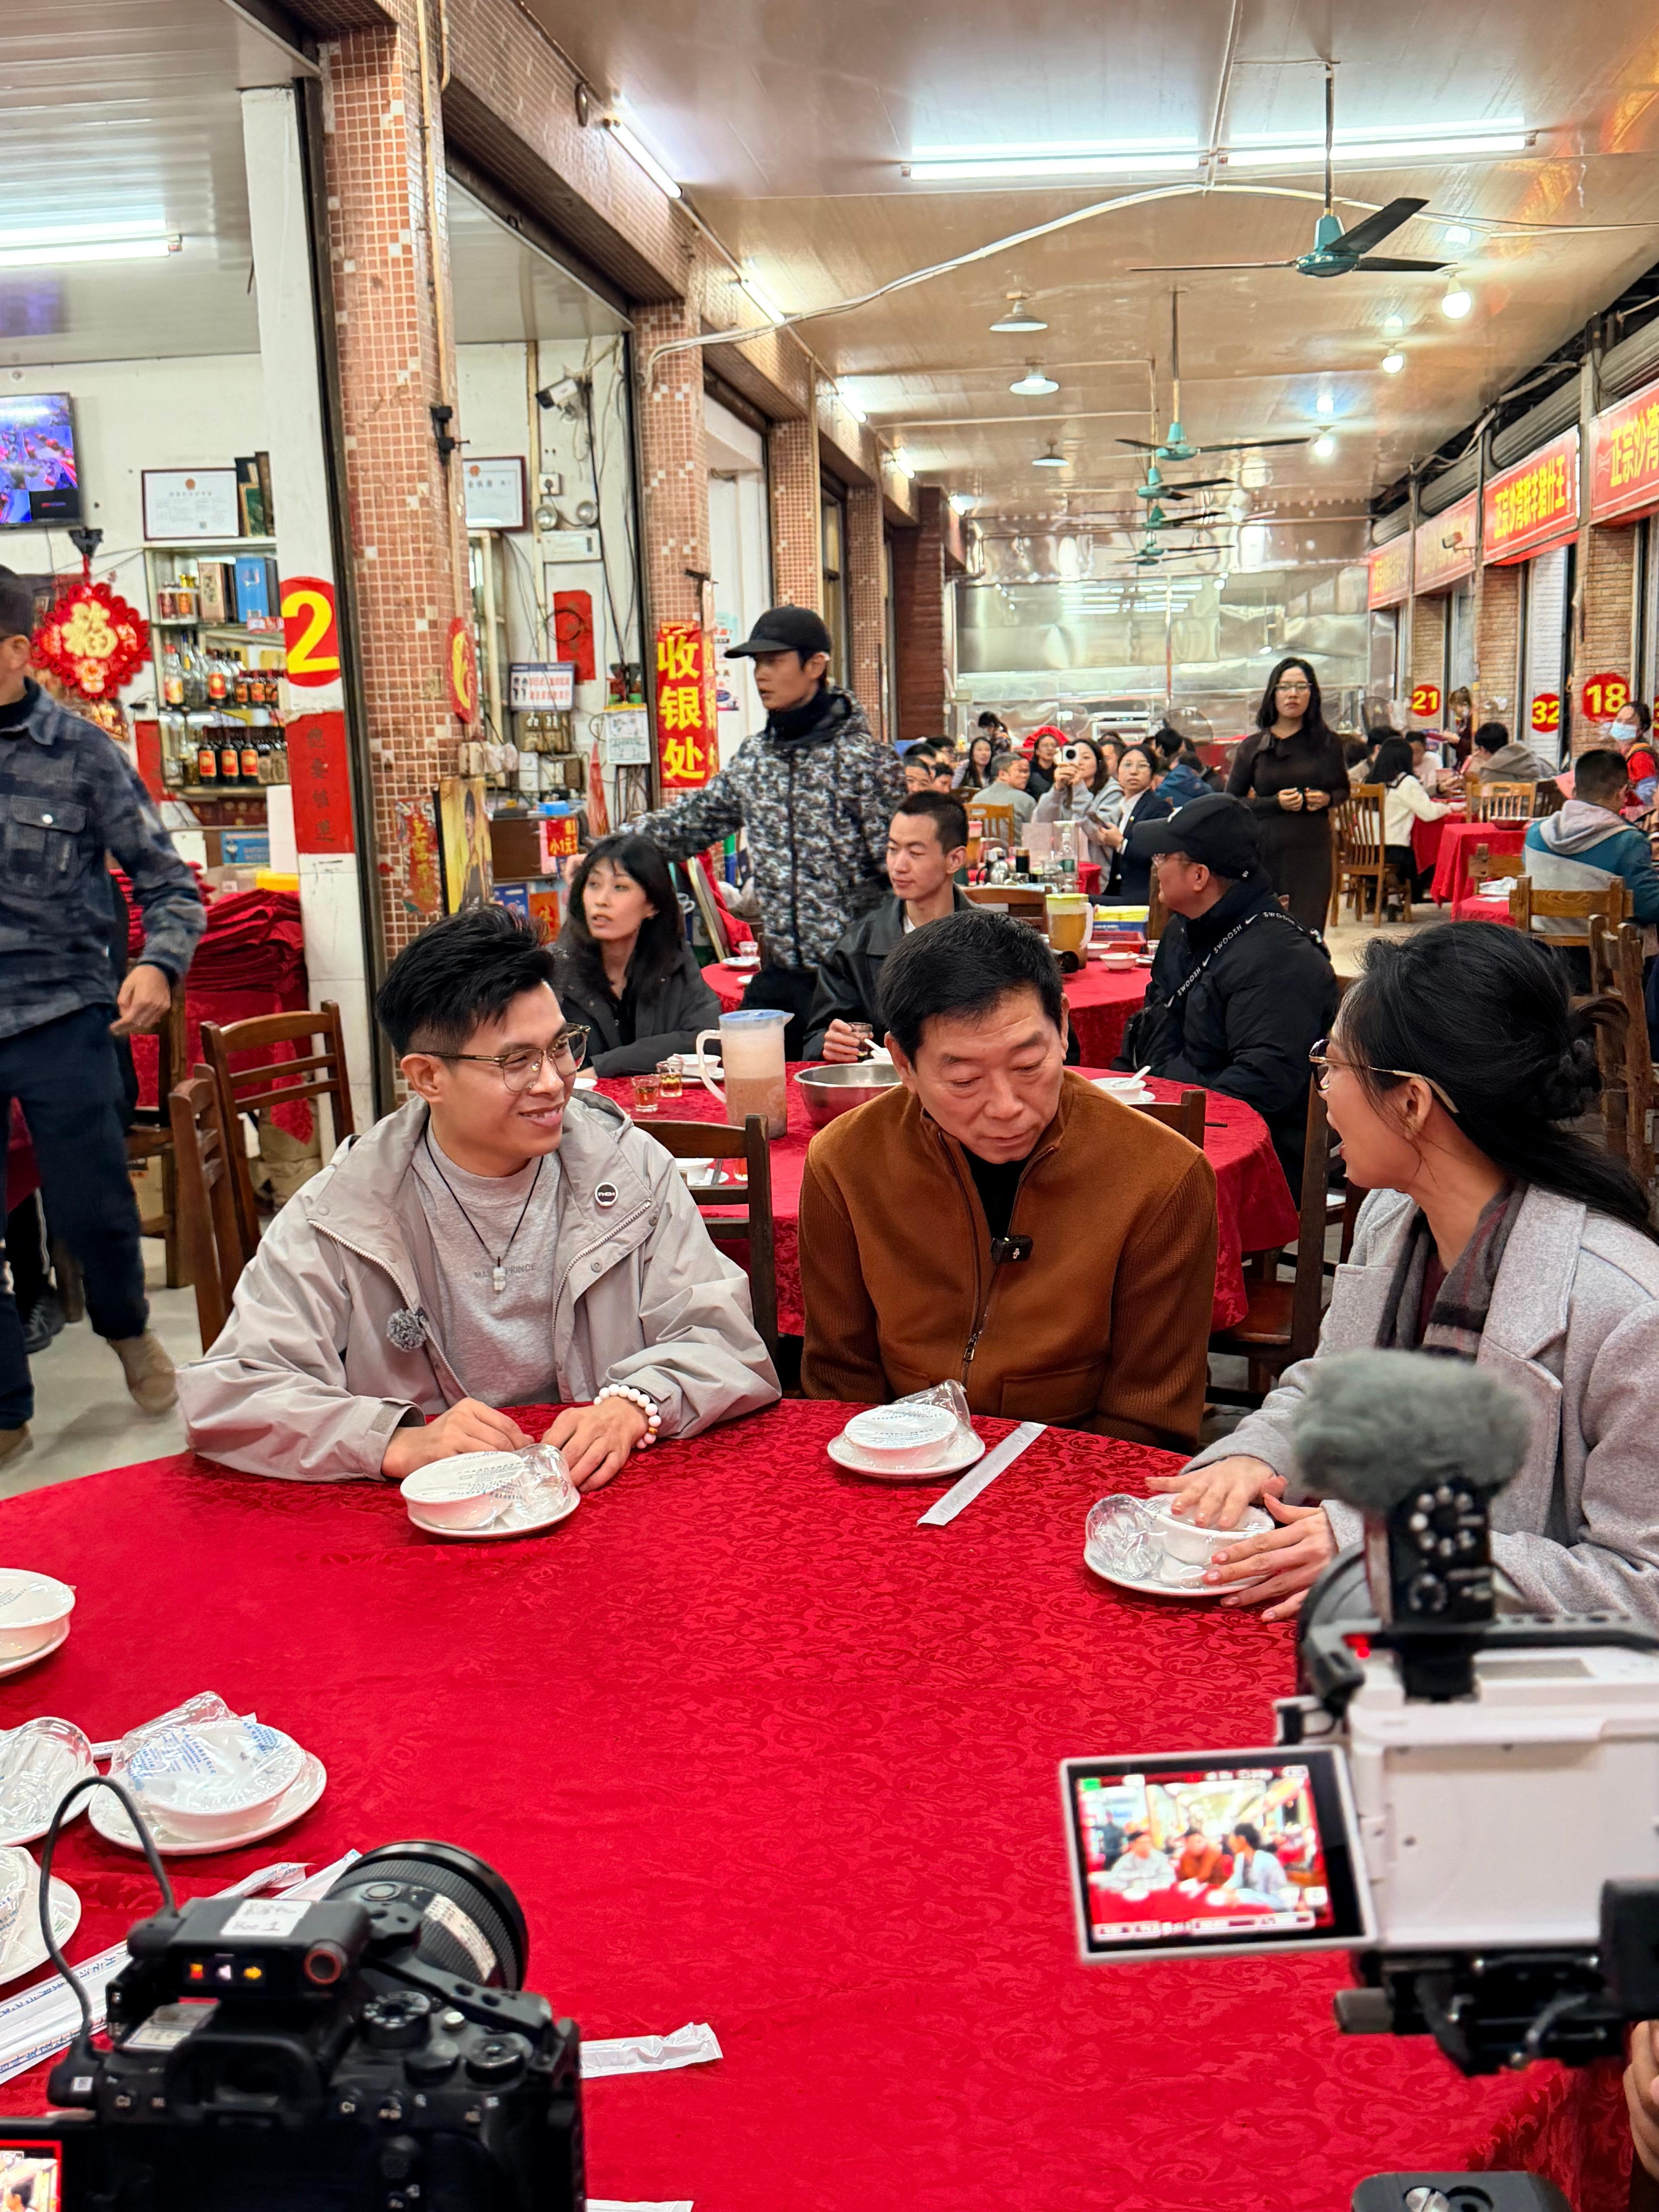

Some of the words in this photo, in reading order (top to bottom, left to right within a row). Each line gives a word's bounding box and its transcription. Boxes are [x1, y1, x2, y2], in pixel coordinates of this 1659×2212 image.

[61, 600, 118, 658] 福
[281, 590, 340, 675] 2
[657, 635, 705, 781] 收银处
[1412, 690, 1438, 710] 21
[1532, 701, 1559, 724] 32
[1587, 684, 1626, 713] 18
[1214, 924, 1242, 954] SWOOSH
[1177, 967, 1202, 997] SWOOSH
[505, 1263, 537, 1275] PRINCE
